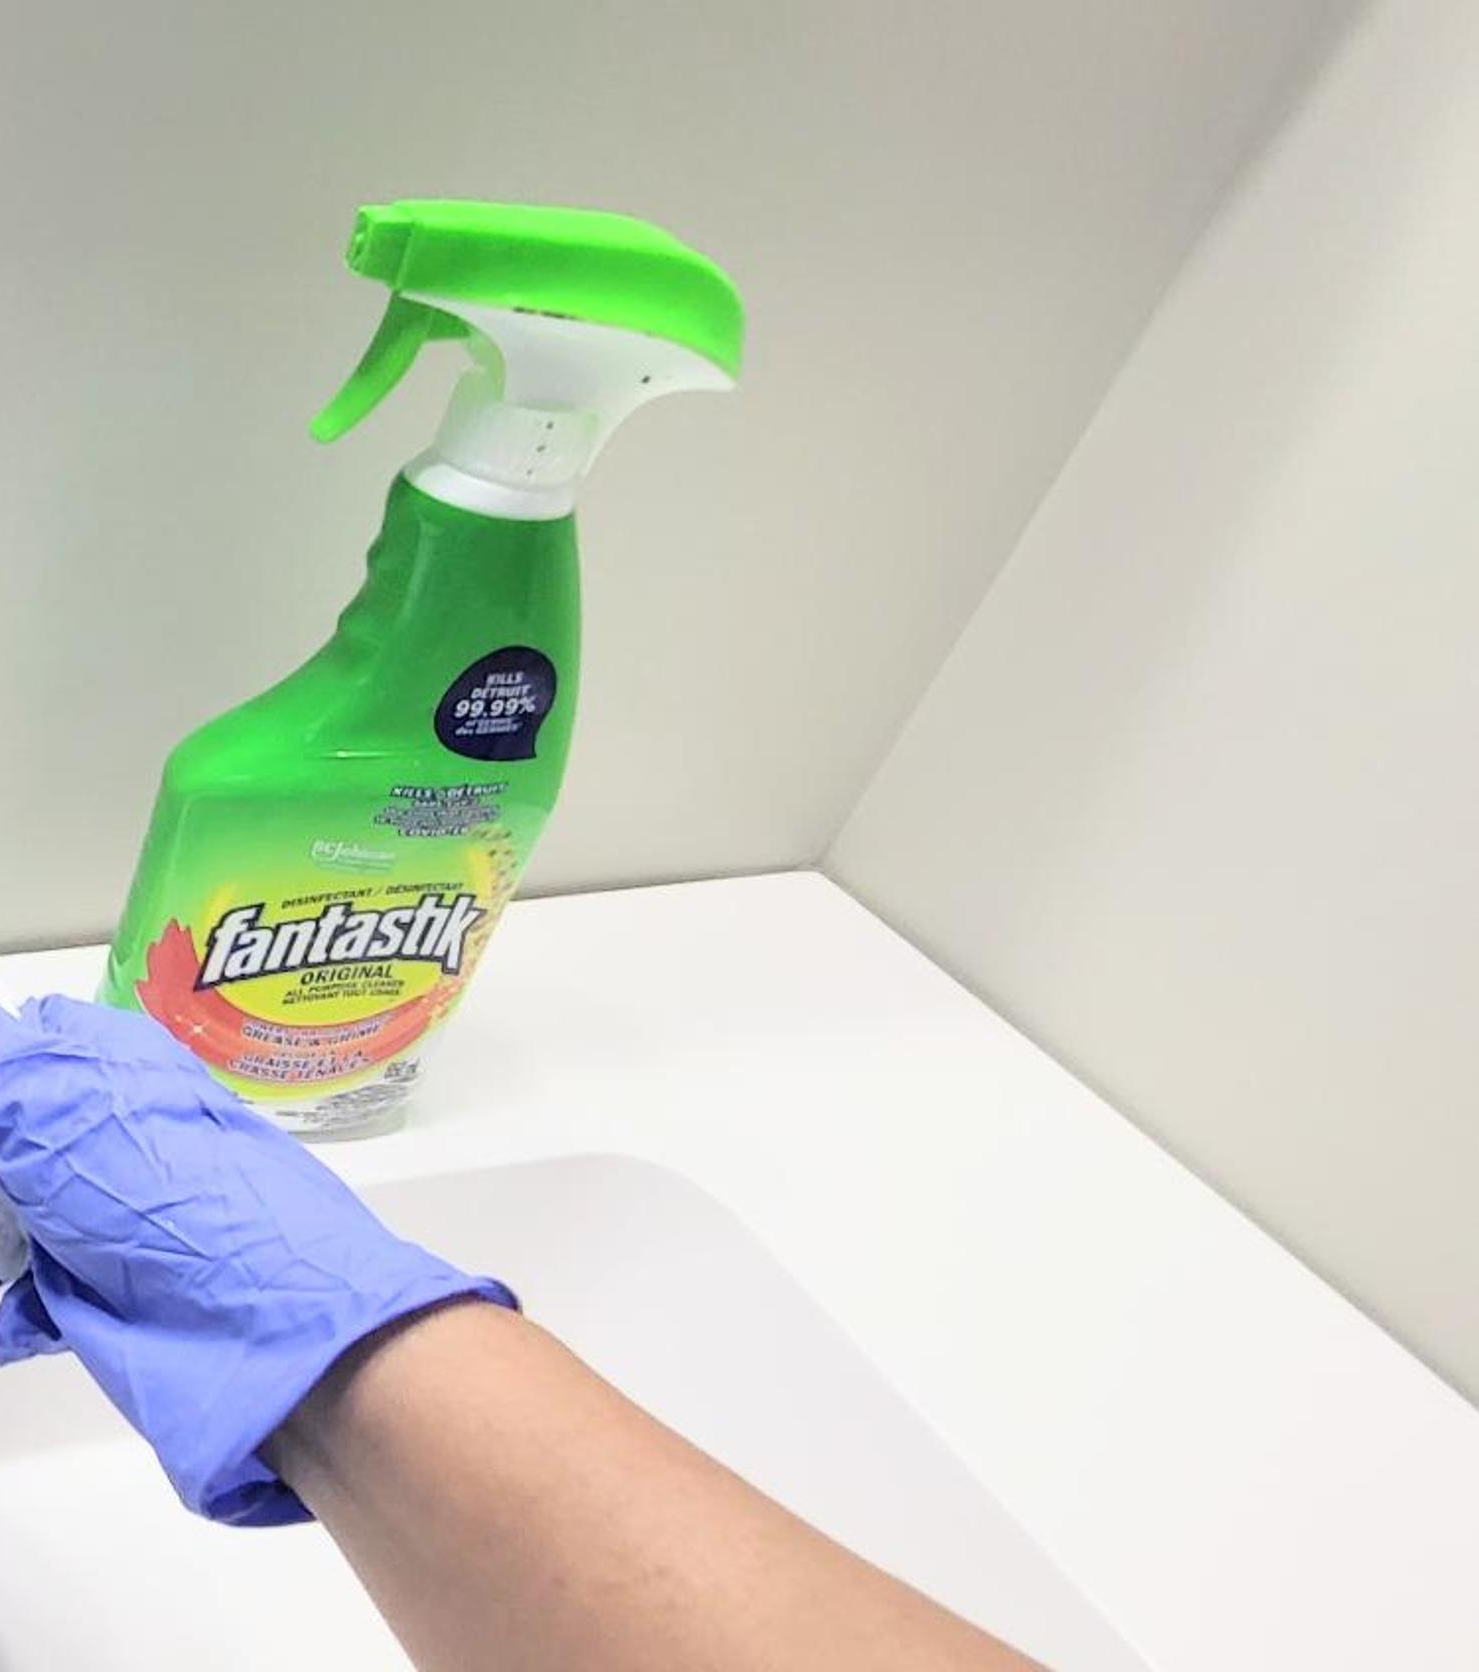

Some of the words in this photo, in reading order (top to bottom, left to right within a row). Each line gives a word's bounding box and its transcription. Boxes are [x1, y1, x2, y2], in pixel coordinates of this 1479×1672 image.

[486, 671, 524, 686] KILLS
[454, 695, 536, 718] 99.99%
[281, 888, 373, 909] DISINFECTANT
[193, 893, 487, 992] fantastik
[300, 964, 393, 985] ORIGINAL
